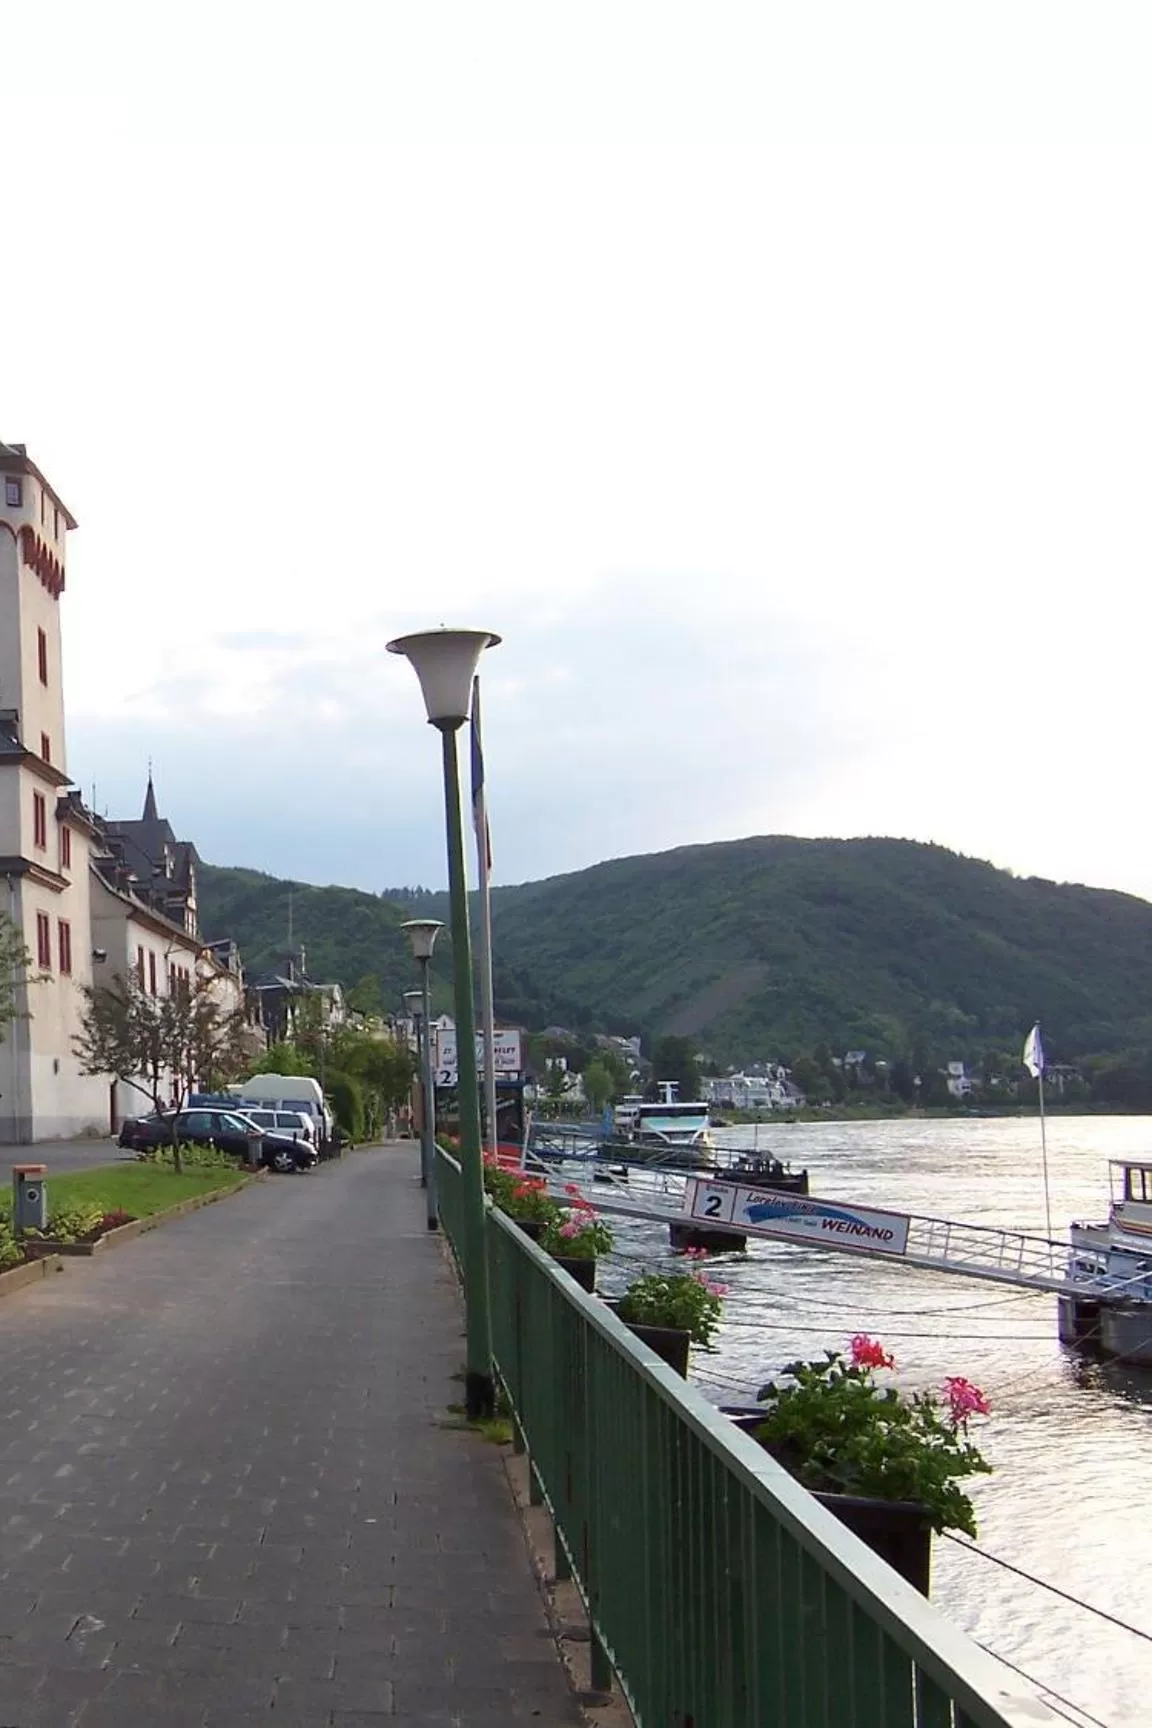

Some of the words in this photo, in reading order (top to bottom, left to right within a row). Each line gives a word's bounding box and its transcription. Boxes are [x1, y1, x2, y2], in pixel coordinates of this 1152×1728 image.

[439, 1070, 452, 1084] 2
[704, 1195, 723, 1217] 2
[820, 1218, 895, 1241] WEINAND
